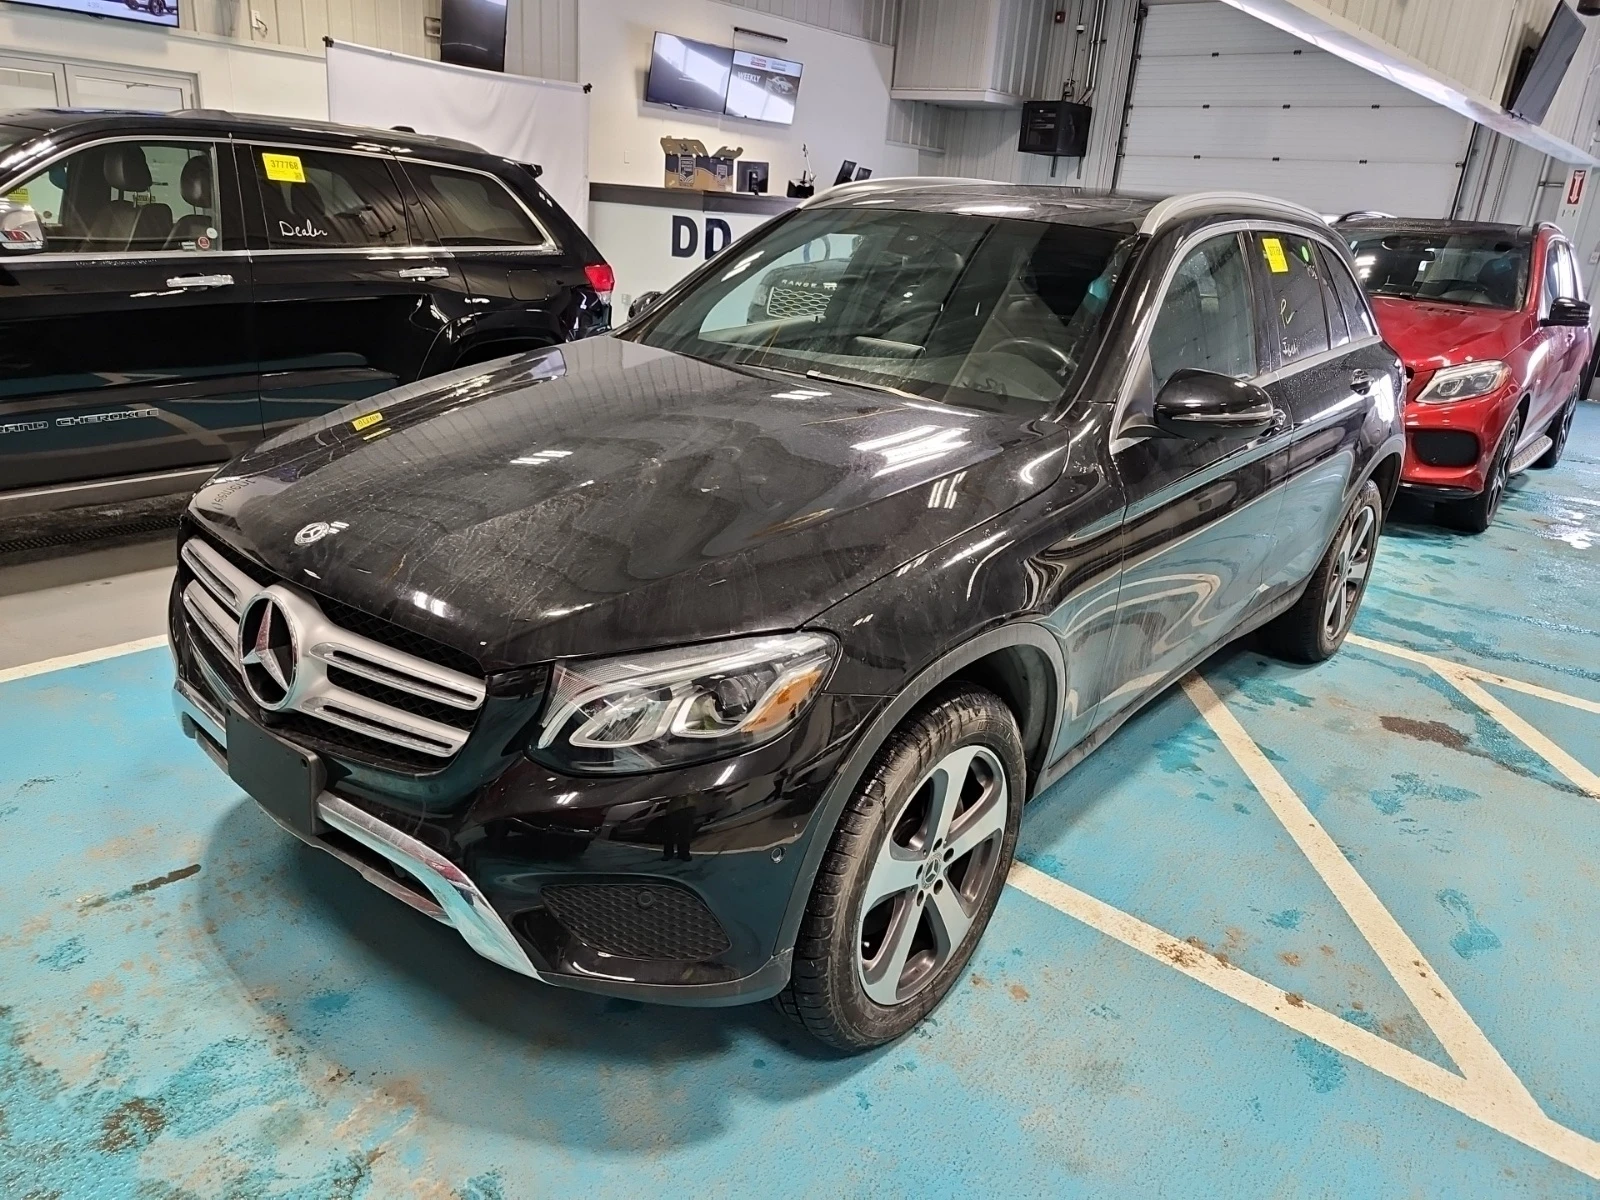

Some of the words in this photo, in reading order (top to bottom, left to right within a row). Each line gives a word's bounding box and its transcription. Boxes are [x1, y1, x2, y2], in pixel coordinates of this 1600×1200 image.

[738, 72, 761, 83] WEEKLY
[269, 159, 299, 170] 377768
[278, 218, 328, 237] Dealer
[55, 408, 159, 427] CHEROKEE
